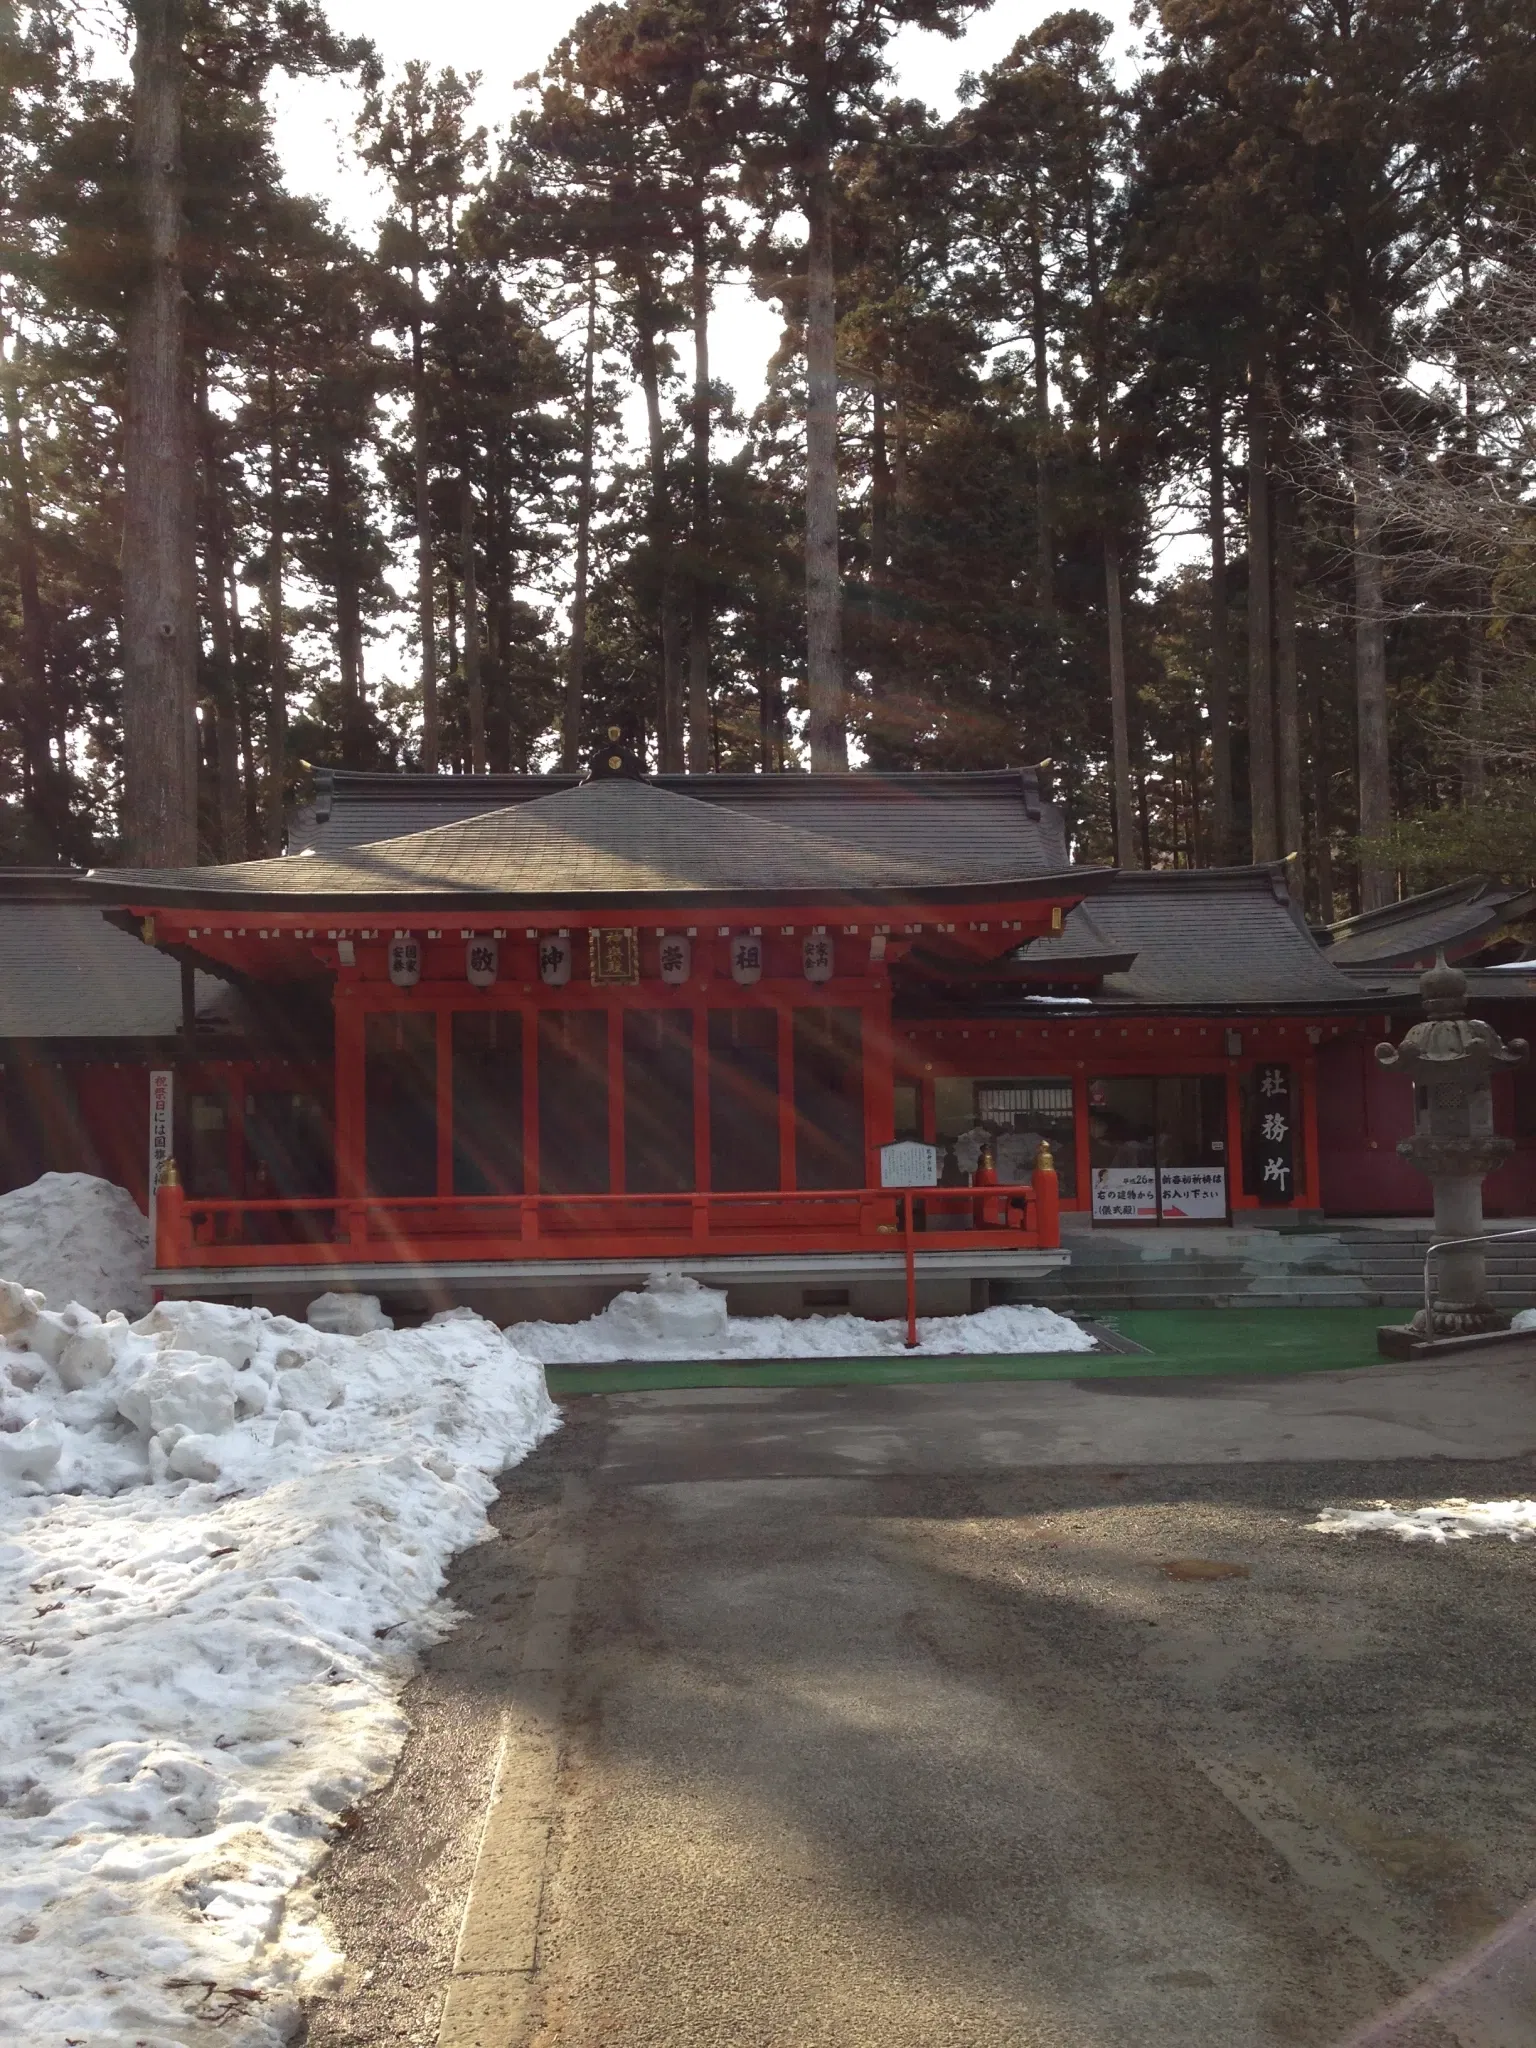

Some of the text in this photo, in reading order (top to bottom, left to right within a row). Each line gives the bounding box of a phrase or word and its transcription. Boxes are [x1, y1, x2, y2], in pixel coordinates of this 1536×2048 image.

[470, 946, 494, 972] 敬
[541, 945, 565, 973] 神
[736, 945, 760, 970] 祖
[804, 942, 816, 969] 安全
[816, 941, 828, 968] 家内
[1260, 1069, 1290, 1192] 社務所
[1097, 1189, 1219, 1200] 右の建物から お入り下さい
